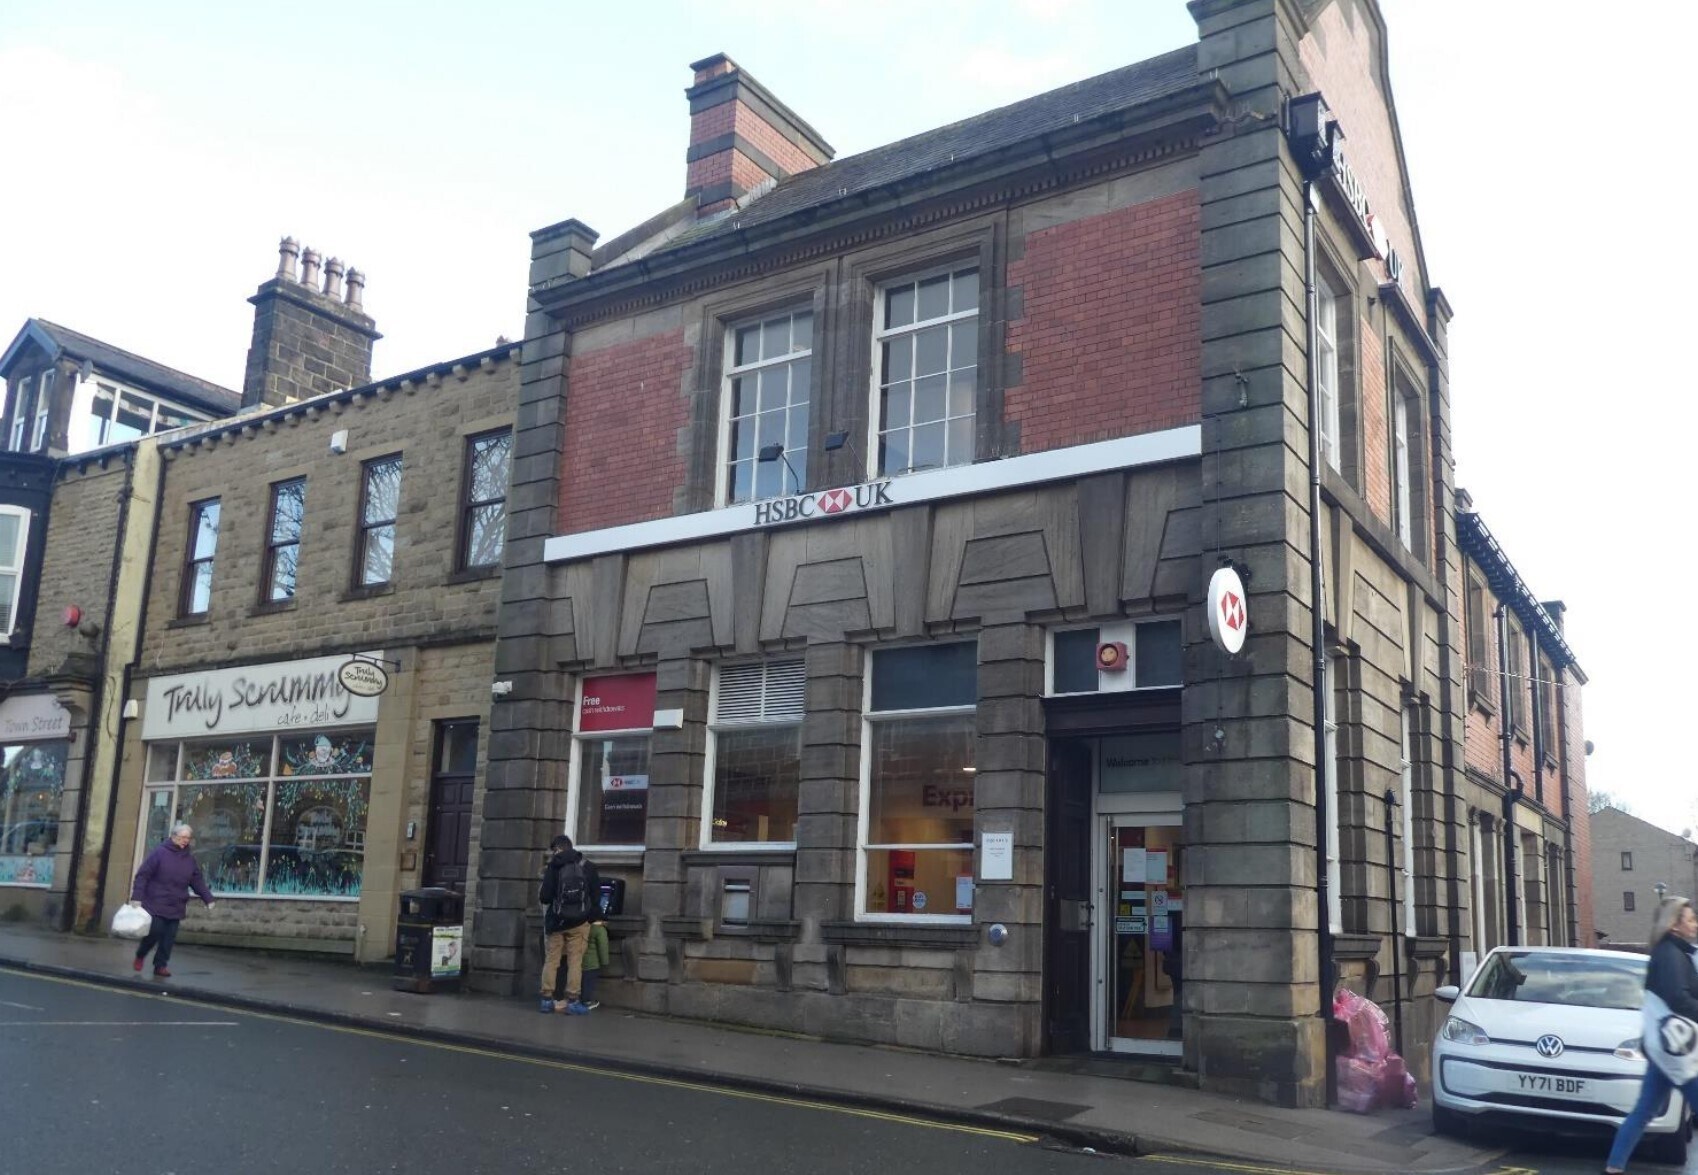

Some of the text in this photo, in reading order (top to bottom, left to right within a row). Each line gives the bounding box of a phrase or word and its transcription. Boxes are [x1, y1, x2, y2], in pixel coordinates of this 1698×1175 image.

[754, 481, 893, 525] HSBC UK
[163, 671, 350, 728] Truly Scrummy
[583, 696, 600, 706] Free
[310, 702, 329, 723] deli
[32, 716, 63, 732] Street
[1519, 1074, 1585, 1093] YY71 BDF
